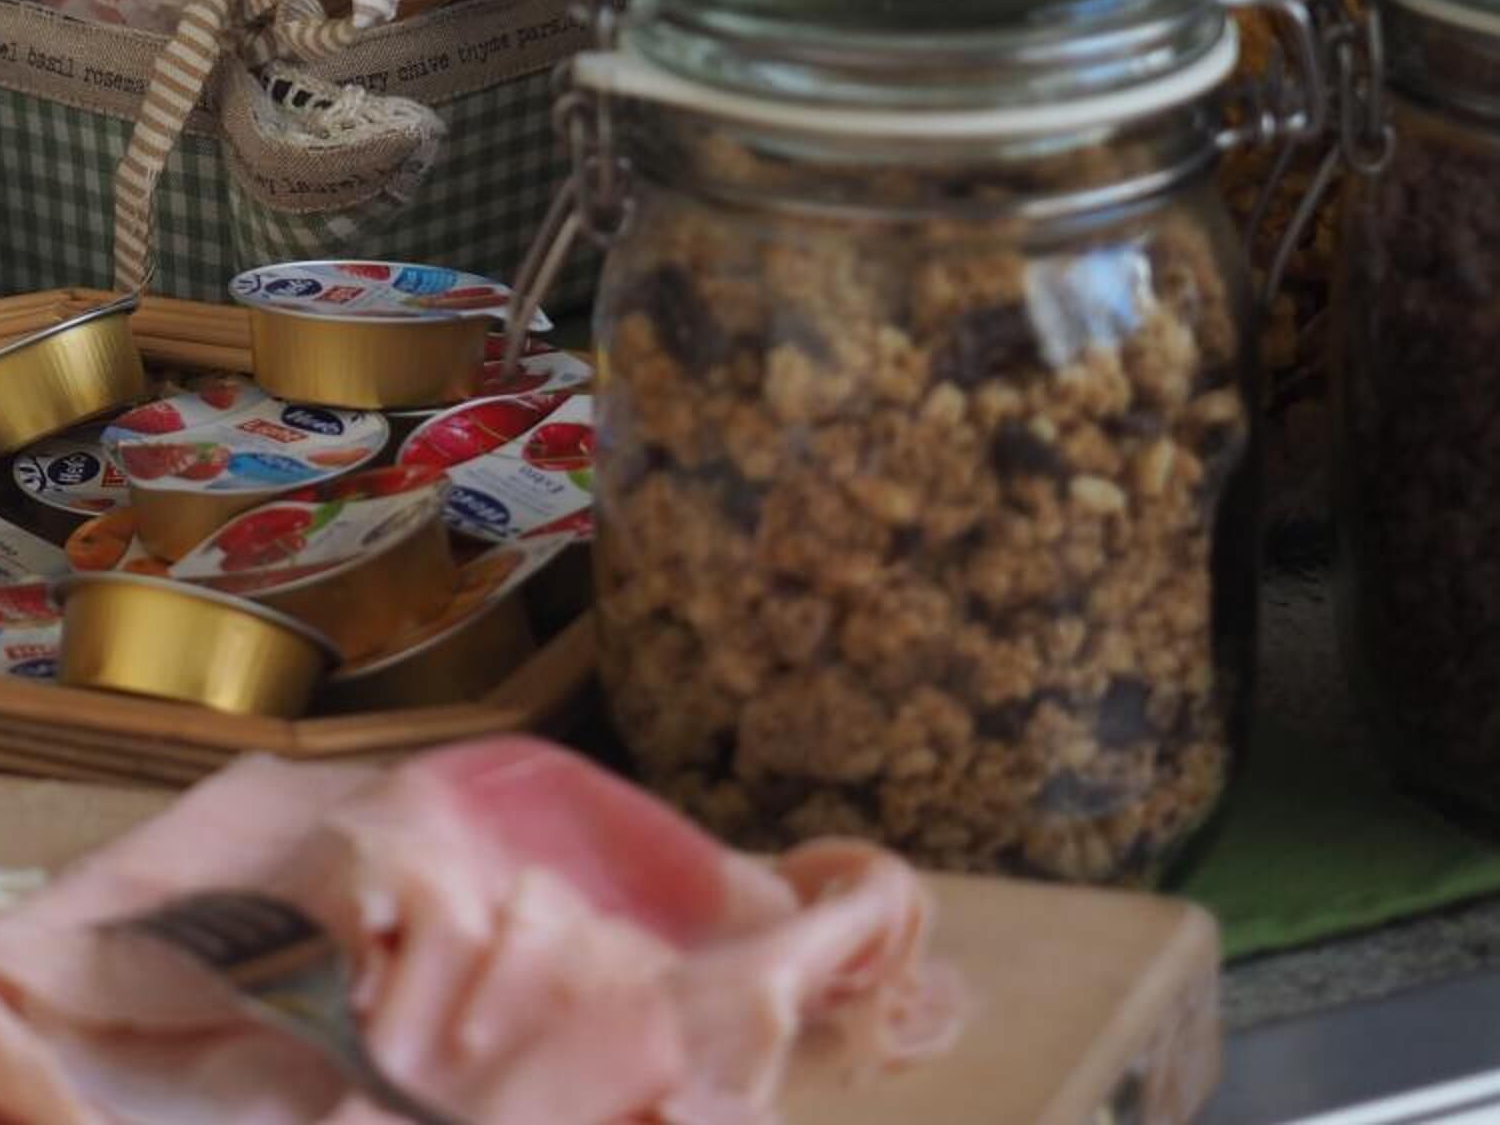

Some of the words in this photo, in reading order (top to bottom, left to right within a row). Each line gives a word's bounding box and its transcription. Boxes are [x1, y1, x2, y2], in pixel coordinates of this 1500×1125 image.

[456, 33, 511, 64] thyme
[27, 46, 75, 79] basil
[82, 65, 151, 95] rosema
